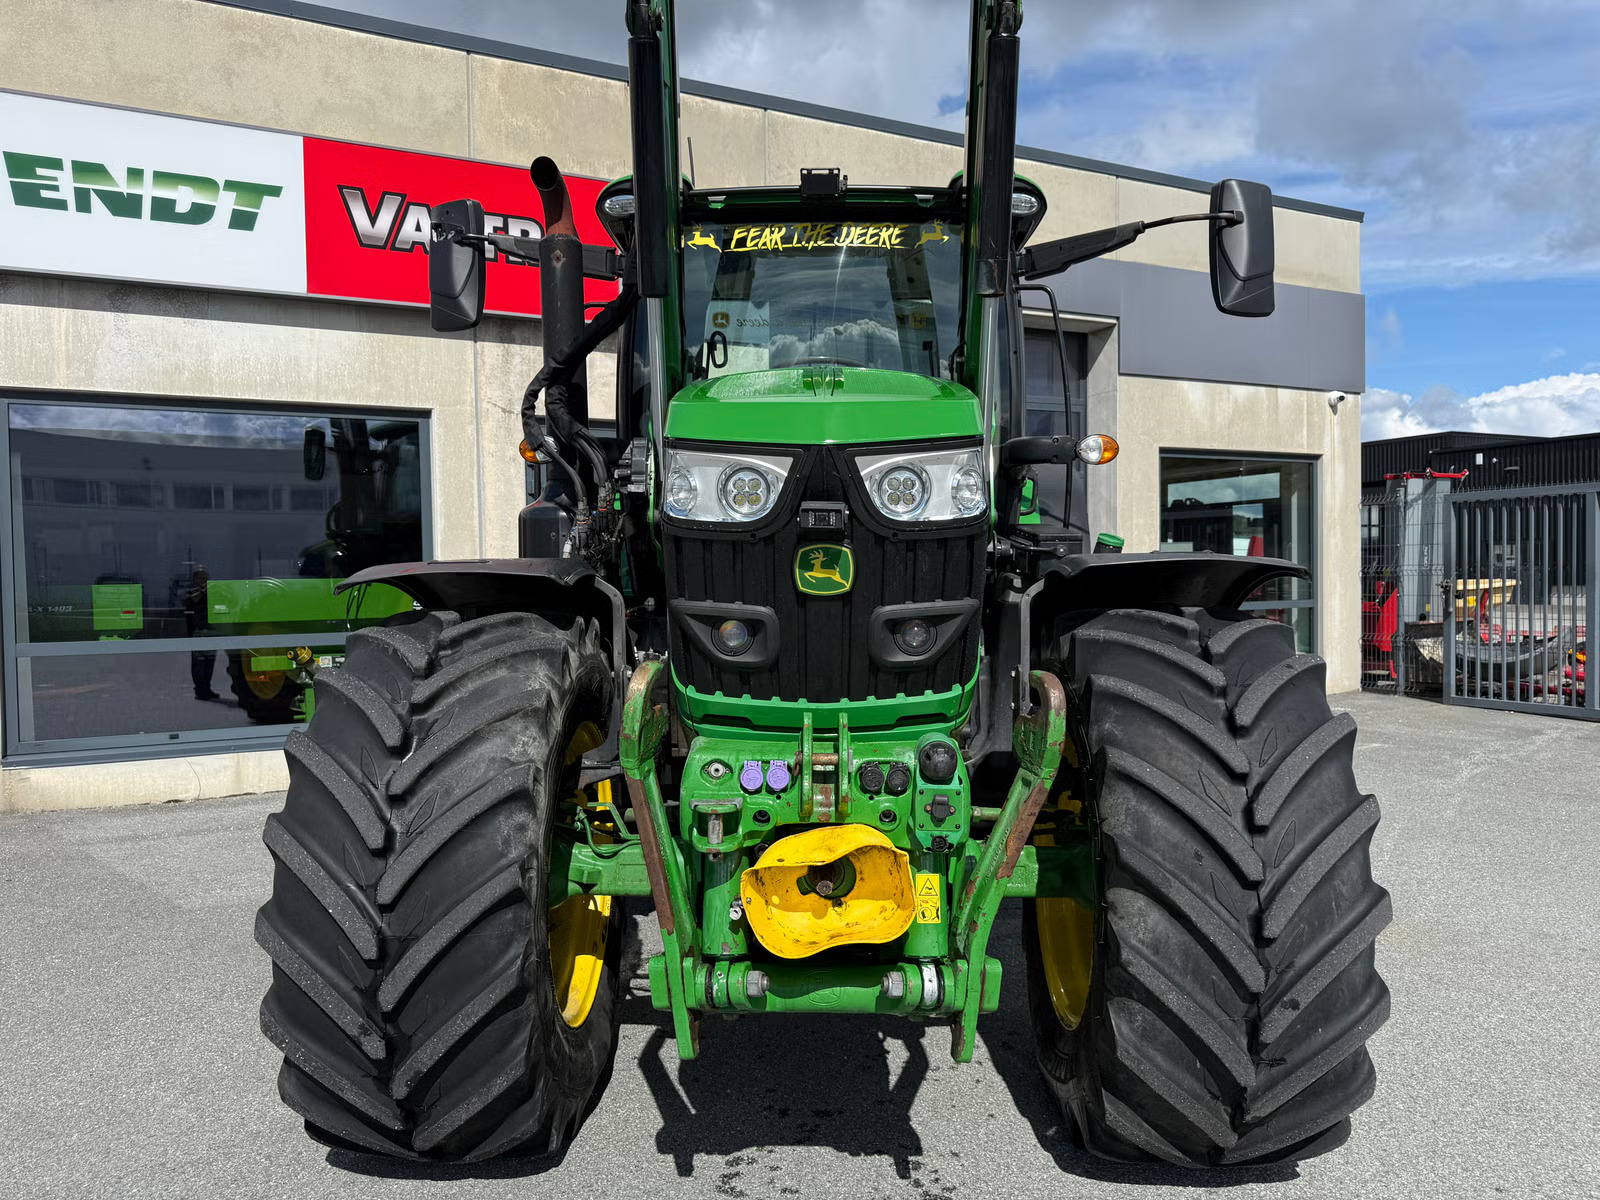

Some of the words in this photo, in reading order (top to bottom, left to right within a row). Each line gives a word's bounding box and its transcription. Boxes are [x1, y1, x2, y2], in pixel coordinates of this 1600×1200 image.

[2, 151, 284, 232] ENDT
[337, 184, 547, 267] VATR
[730, 223, 787, 251] FEAR
[790, 223, 836, 250] THE
[833, 222, 910, 250] DEERE
